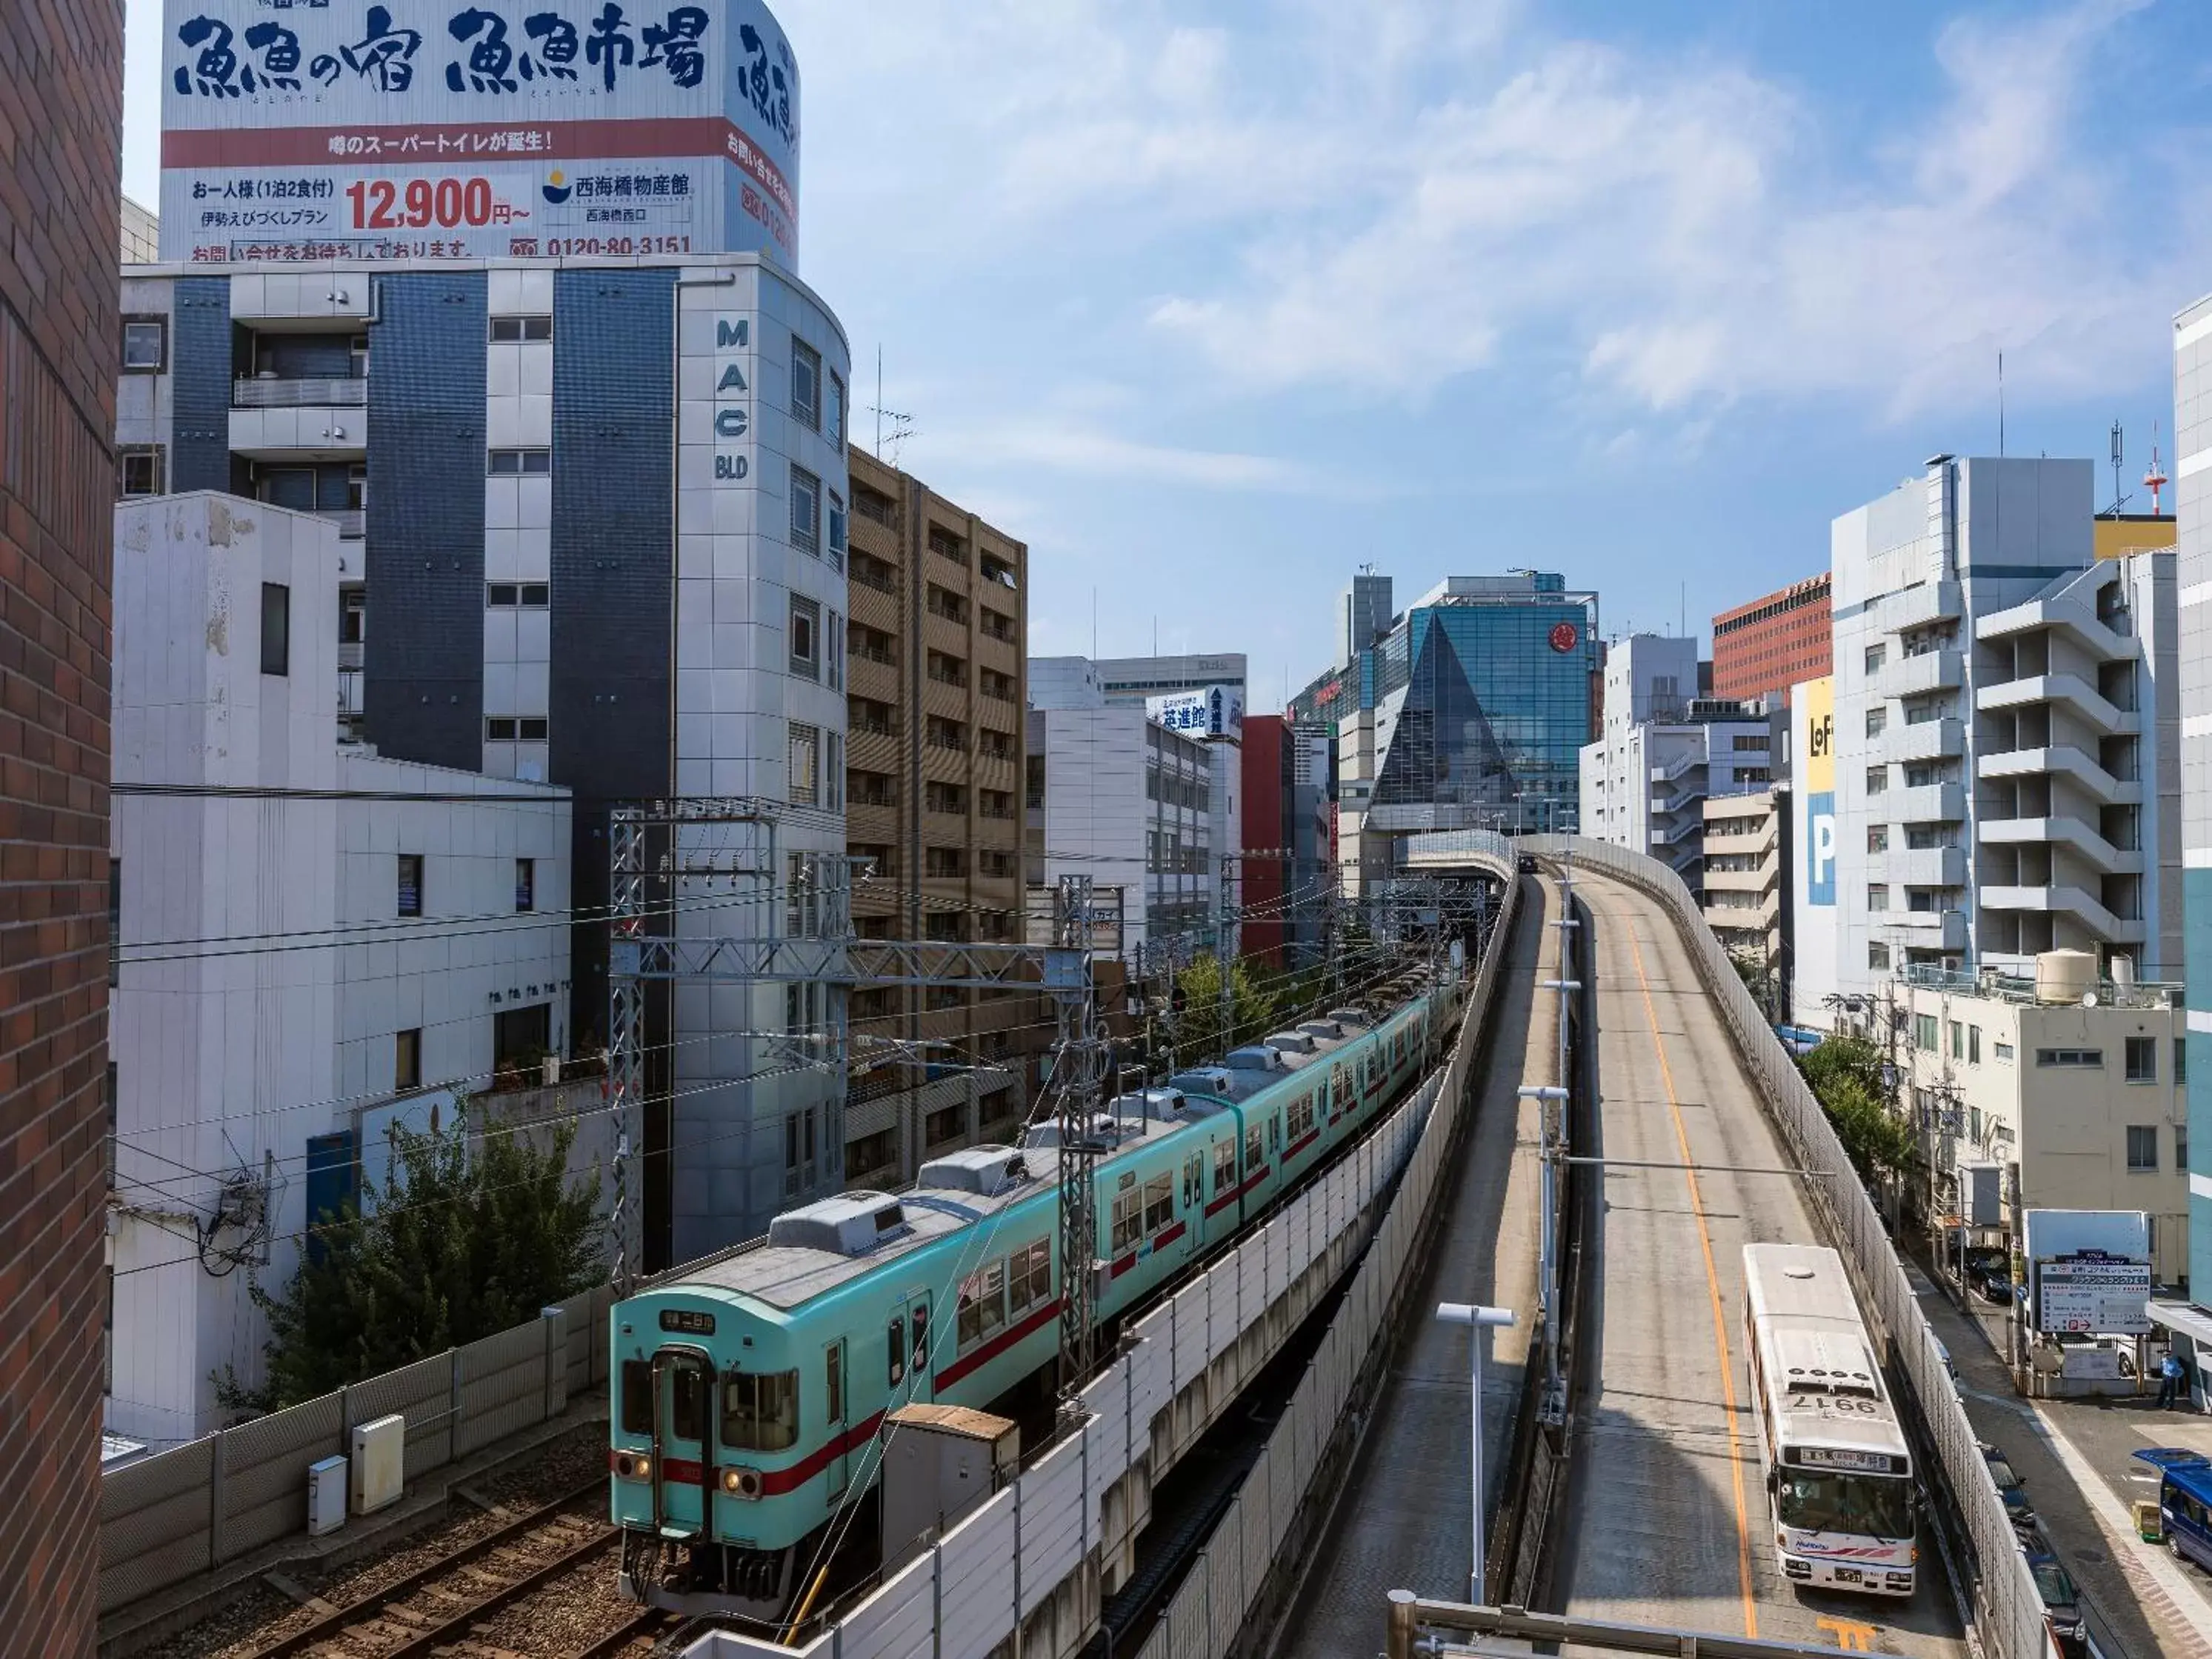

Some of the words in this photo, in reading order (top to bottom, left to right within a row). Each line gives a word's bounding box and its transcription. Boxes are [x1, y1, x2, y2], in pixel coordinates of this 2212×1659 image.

[444, 2, 709, 94] 魚魚市場
[576, 173, 690, 197] 西海橋物産館
[586, 208, 646, 223] 西海橋西口
[715, 455, 748, 479] BLD
[1164, 704, 1206, 731] 英進館
[1813, 814, 1835, 884] P
